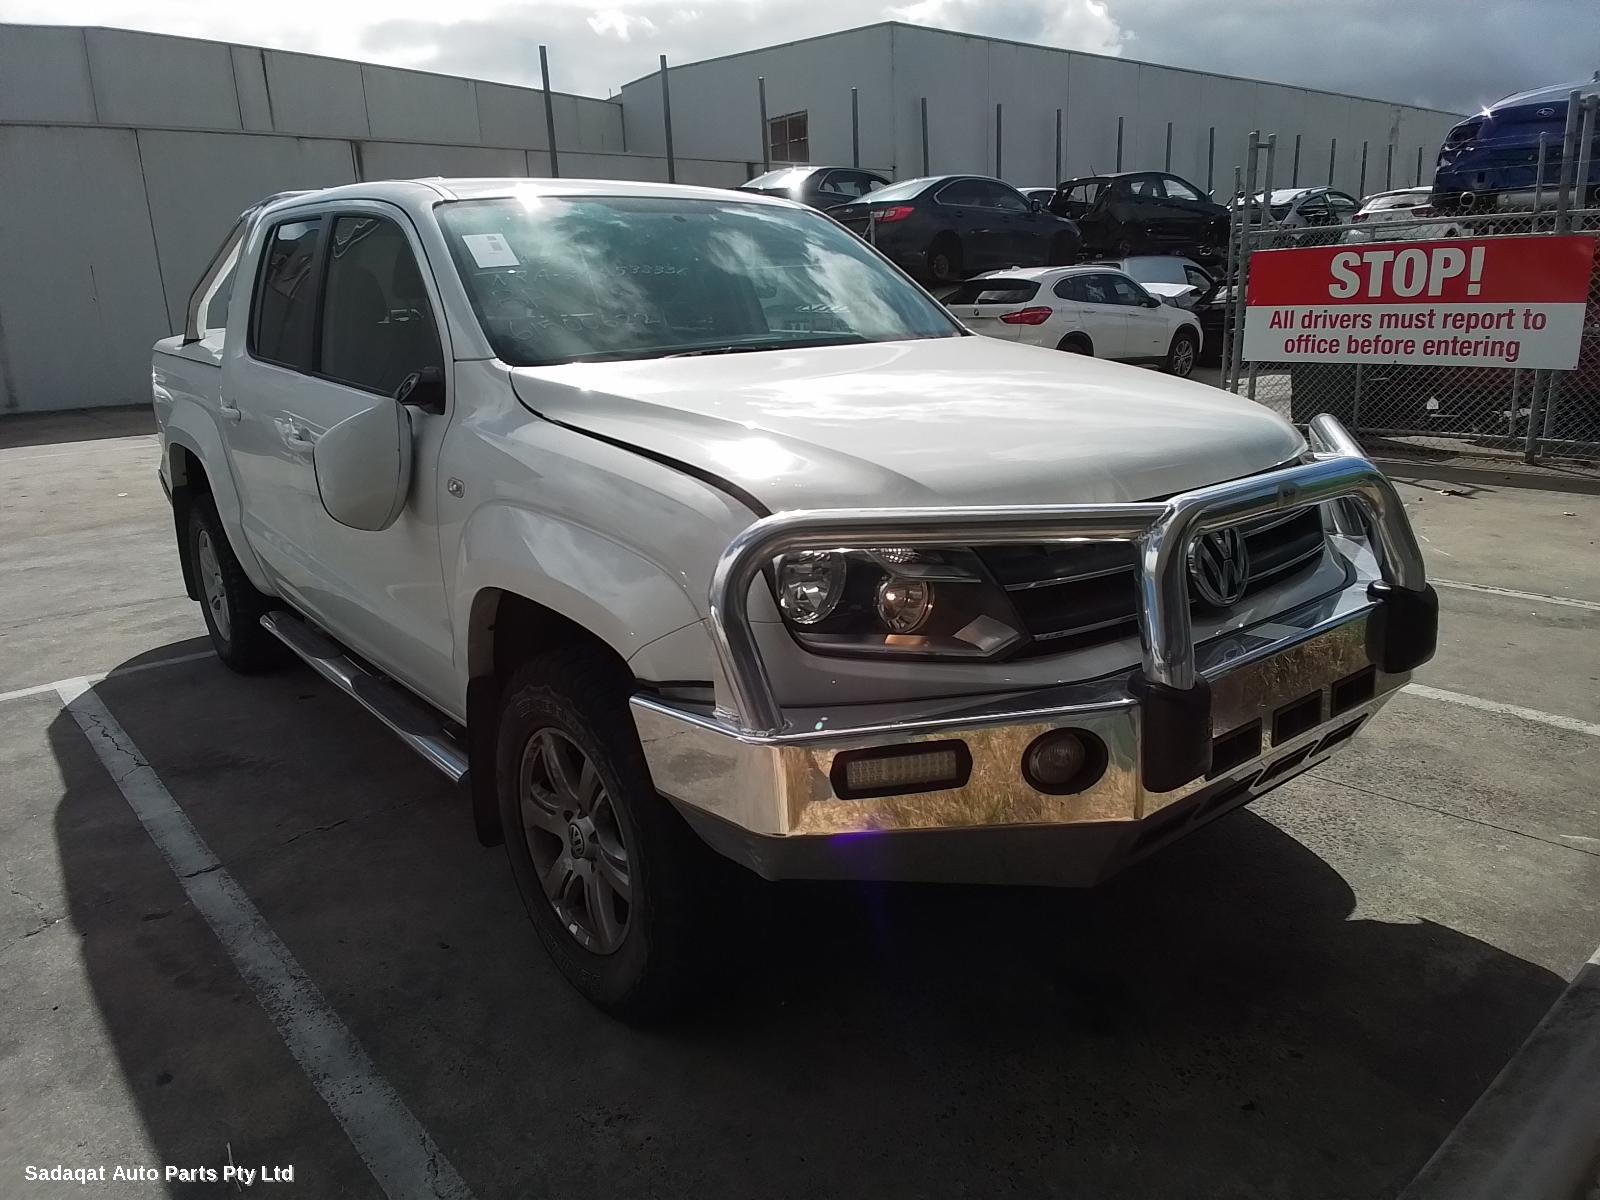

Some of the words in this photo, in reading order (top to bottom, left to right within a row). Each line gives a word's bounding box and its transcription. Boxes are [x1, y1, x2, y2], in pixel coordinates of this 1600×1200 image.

[1328, 246, 1486, 298] STOP!
[1269, 310, 1294, 329] All
[1300, 309, 1372, 330] drivers
[1379, 309, 1436, 330] must
[1442, 308, 1515, 334] report
[1523, 309, 1547, 331] to
[1284, 334, 1340, 354] office
[1346, 335, 1415, 356] before
[1422, 336, 1521, 362] entering
